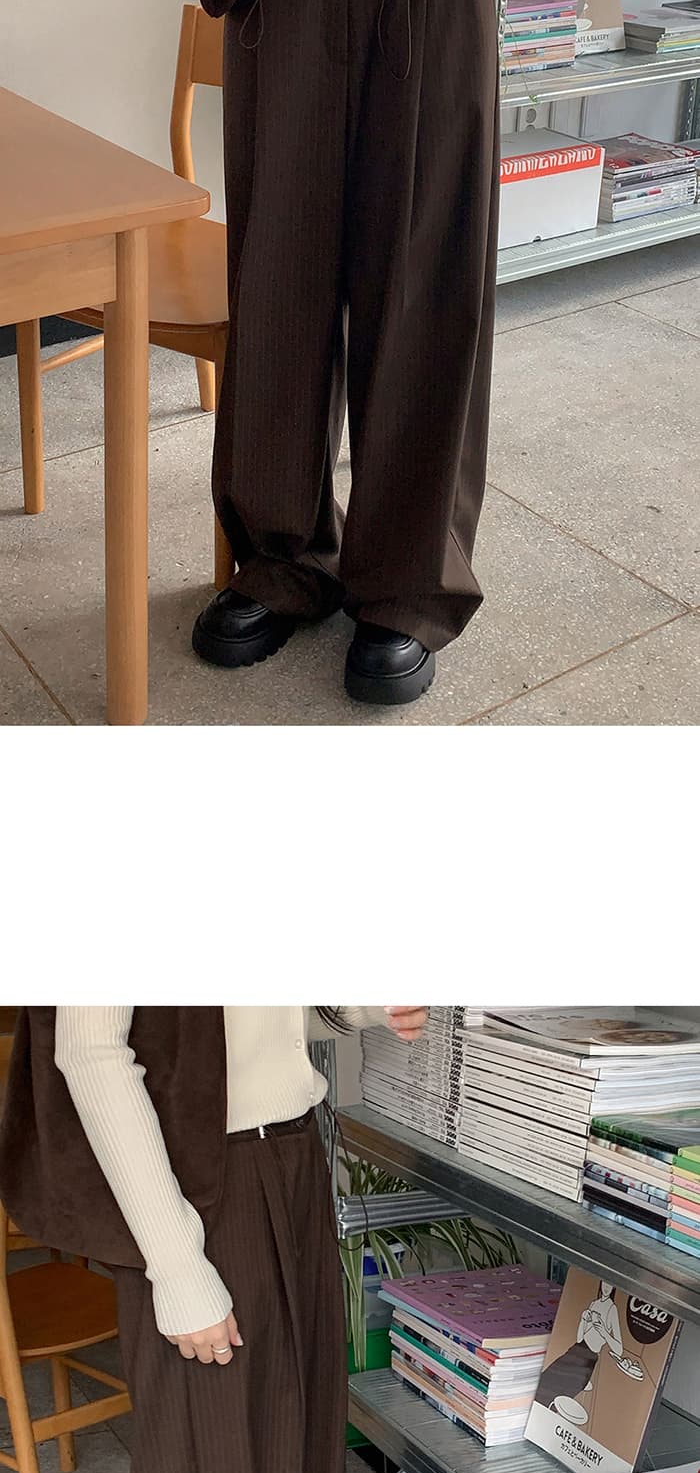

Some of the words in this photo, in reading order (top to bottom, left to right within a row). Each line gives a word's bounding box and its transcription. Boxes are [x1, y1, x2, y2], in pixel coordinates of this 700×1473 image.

[591, 33, 609, 42] BAKERY
[555, 1425, 573, 1444] CAFE
[571, 1436, 577, 1447] &
[577, 1440, 604, 1466] BAKERY
